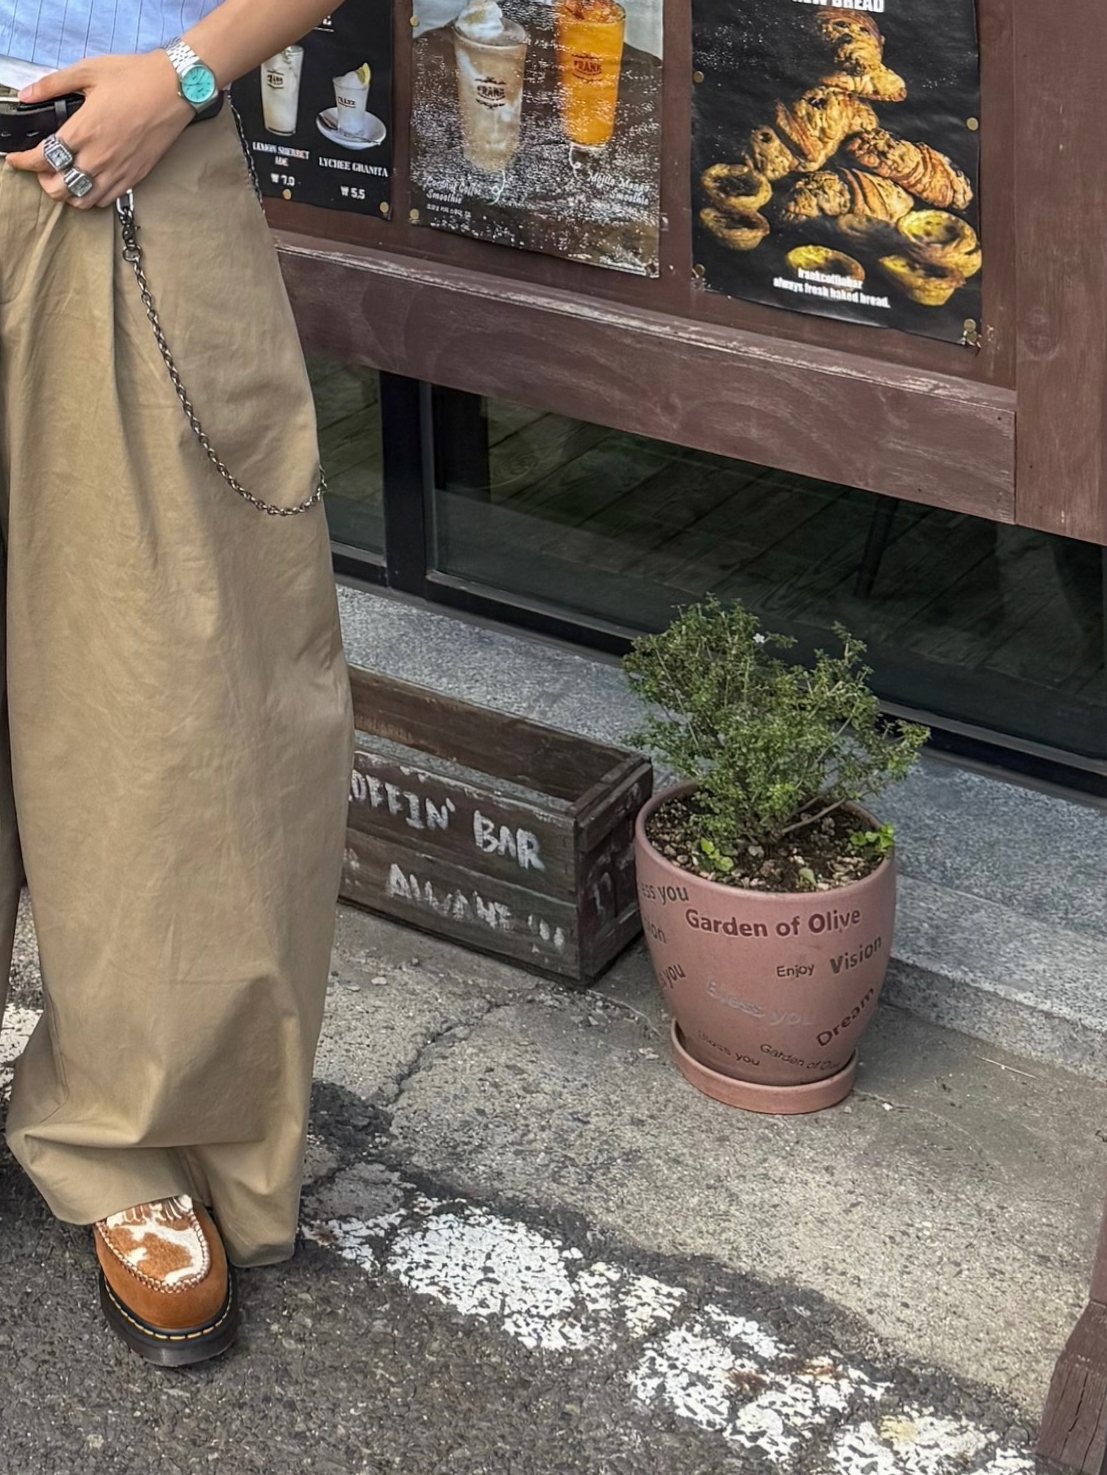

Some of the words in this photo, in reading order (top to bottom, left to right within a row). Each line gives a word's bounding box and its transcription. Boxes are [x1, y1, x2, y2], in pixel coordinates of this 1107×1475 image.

[574, 60, 602, 73] FRANK
[319, 157, 351, 171] LYCHEE
[352, 162, 388, 177] GRANITA
[281, 174, 295, 186] 7.0
[351, 188, 365, 199] 5.5
[773, 277, 803, 293] always
[804, 283, 829, 298] fresh
[830, 287, 859, 303] baked
[349, 768, 455, 830] OFFIN'
[474, 810, 545, 871] BAR
[658, 886, 690, 905] you
[686, 909, 768, 937] Garden
[776, 916, 800, 937] of
[809, 909, 861, 933] Olive
[829, 936, 882, 974] Vision
[776, 964, 815, 979] Enjoy
[817, 987, 874, 1047] Dream
[735, 1052, 761, 1066] you
[760, 1044, 805, 1067] Garden
